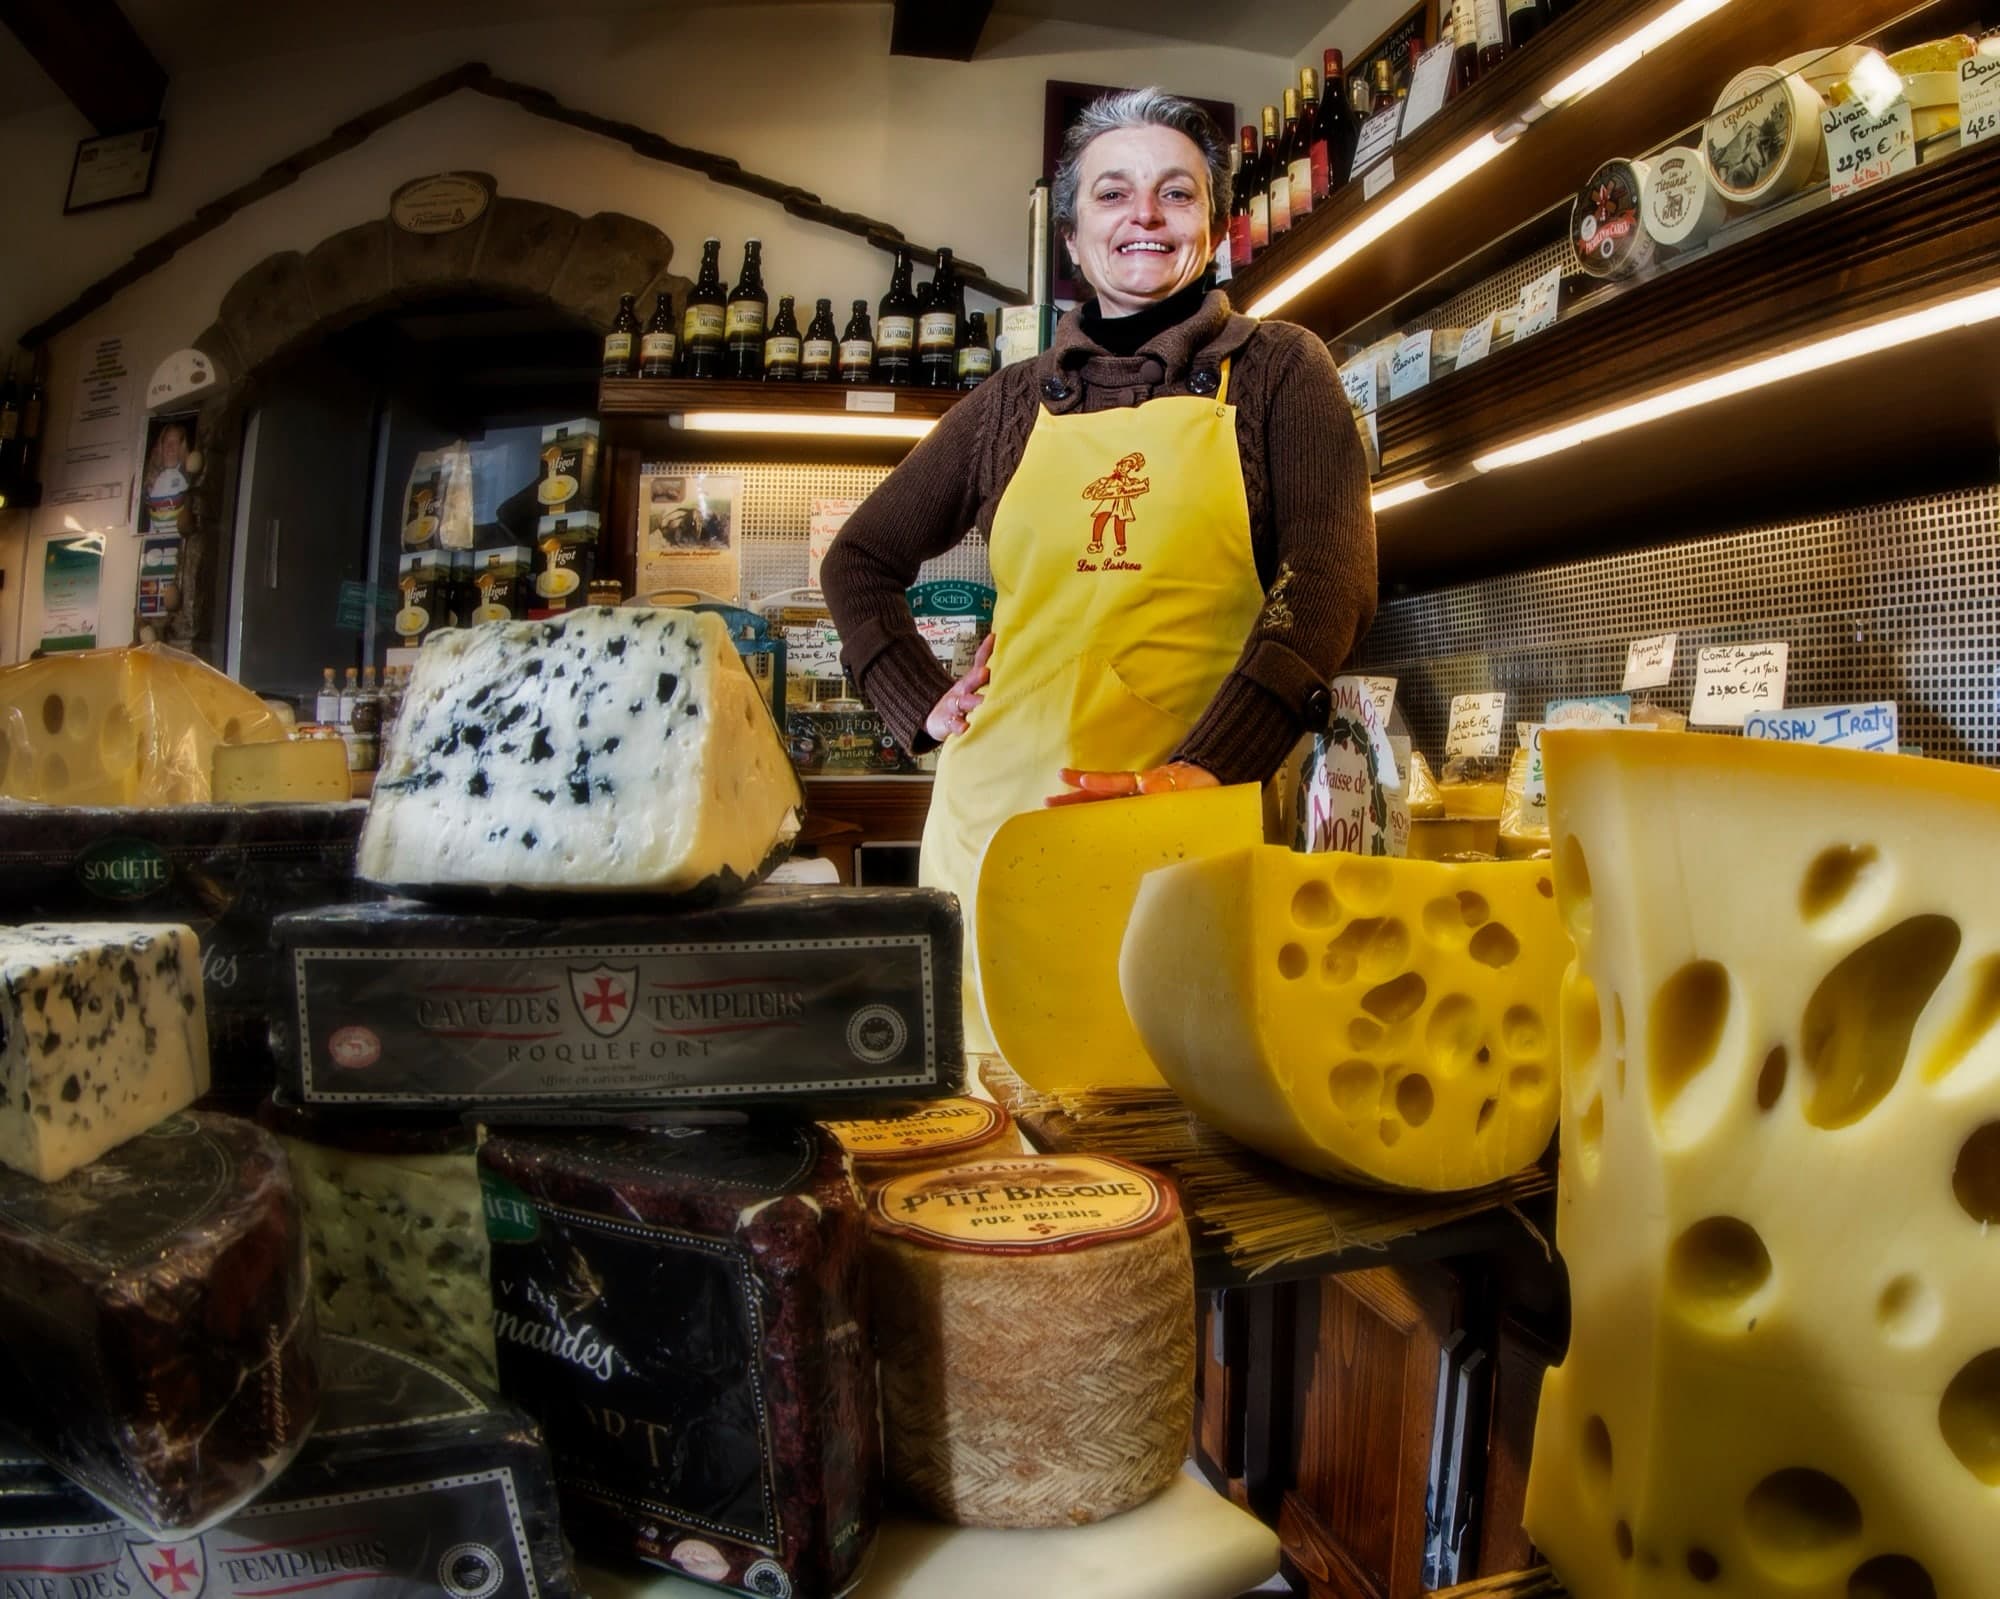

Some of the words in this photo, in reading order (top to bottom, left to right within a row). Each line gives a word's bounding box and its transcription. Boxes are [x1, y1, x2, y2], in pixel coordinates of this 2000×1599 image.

[1722, 94, 1765, 129] L'ENCALAT
[1076, 558, 1098, 573] Lou
[1701, 645, 1734, 661] Comté
[1354, 770, 1367, 795] de
[1313, 794, 1365, 856] Noël
[416, 998, 494, 1028] CAVE
[506, 997, 561, 1026] DES
[647, 991, 806, 1021] TEMPLIERS
[507, 1039, 713, 1065] ROQUEFORT
[851, 1132, 885, 1143] PUR
[892, 1126, 955, 1139] BREBIS
[1004, 1182, 1143, 1202] BASQUE
[970, 1213, 1016, 1228] PUR
[1023, 1208, 1103, 1222] BREBIS
[493, 1308, 616, 1381] naudes
[1, 1576, 57, 1599] AVE
[69, 1571, 131, 1599] DES
[219, 1541, 390, 1585] TEMPLIERS
